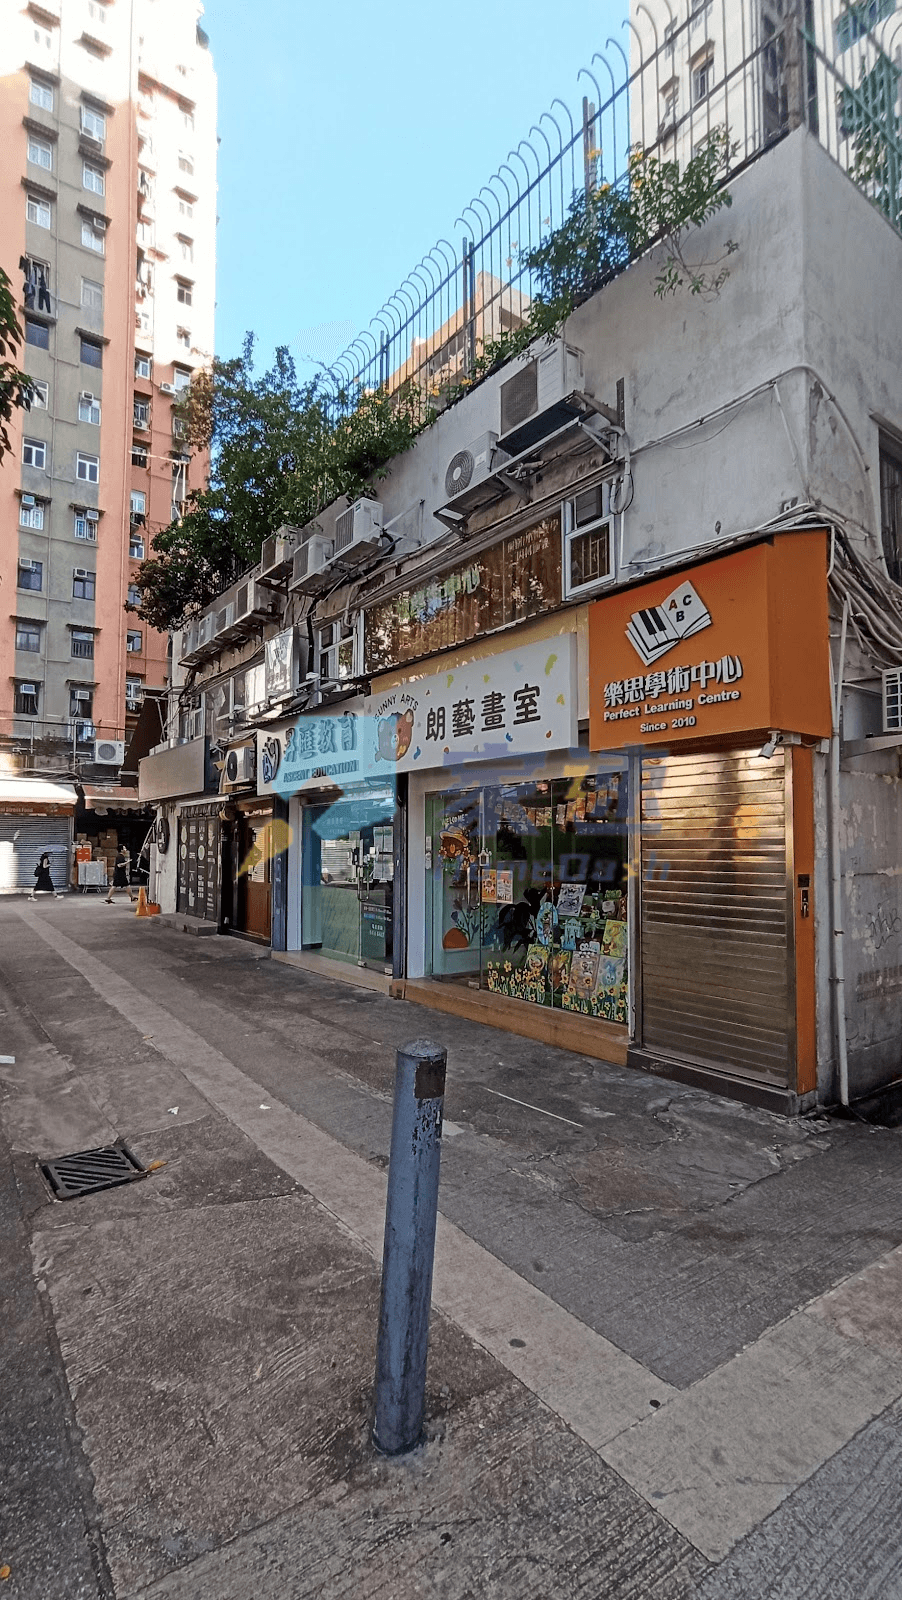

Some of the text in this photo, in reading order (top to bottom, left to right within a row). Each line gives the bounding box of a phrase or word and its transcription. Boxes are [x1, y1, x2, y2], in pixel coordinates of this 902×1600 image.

[682, 594, 693, 606] C
[675, 610, 685, 622] B
[603, 654, 744, 709] 樂思學術中心
[374, 693, 419, 721] SUNNY ARTS
[425, 683, 541, 741] 朗藝畫室
[603, 690, 742, 722] Perfect Learning Centre
[640, 715, 697, 734] Since 2010
[283, 760, 359, 783] ASCENT EDUCATION
